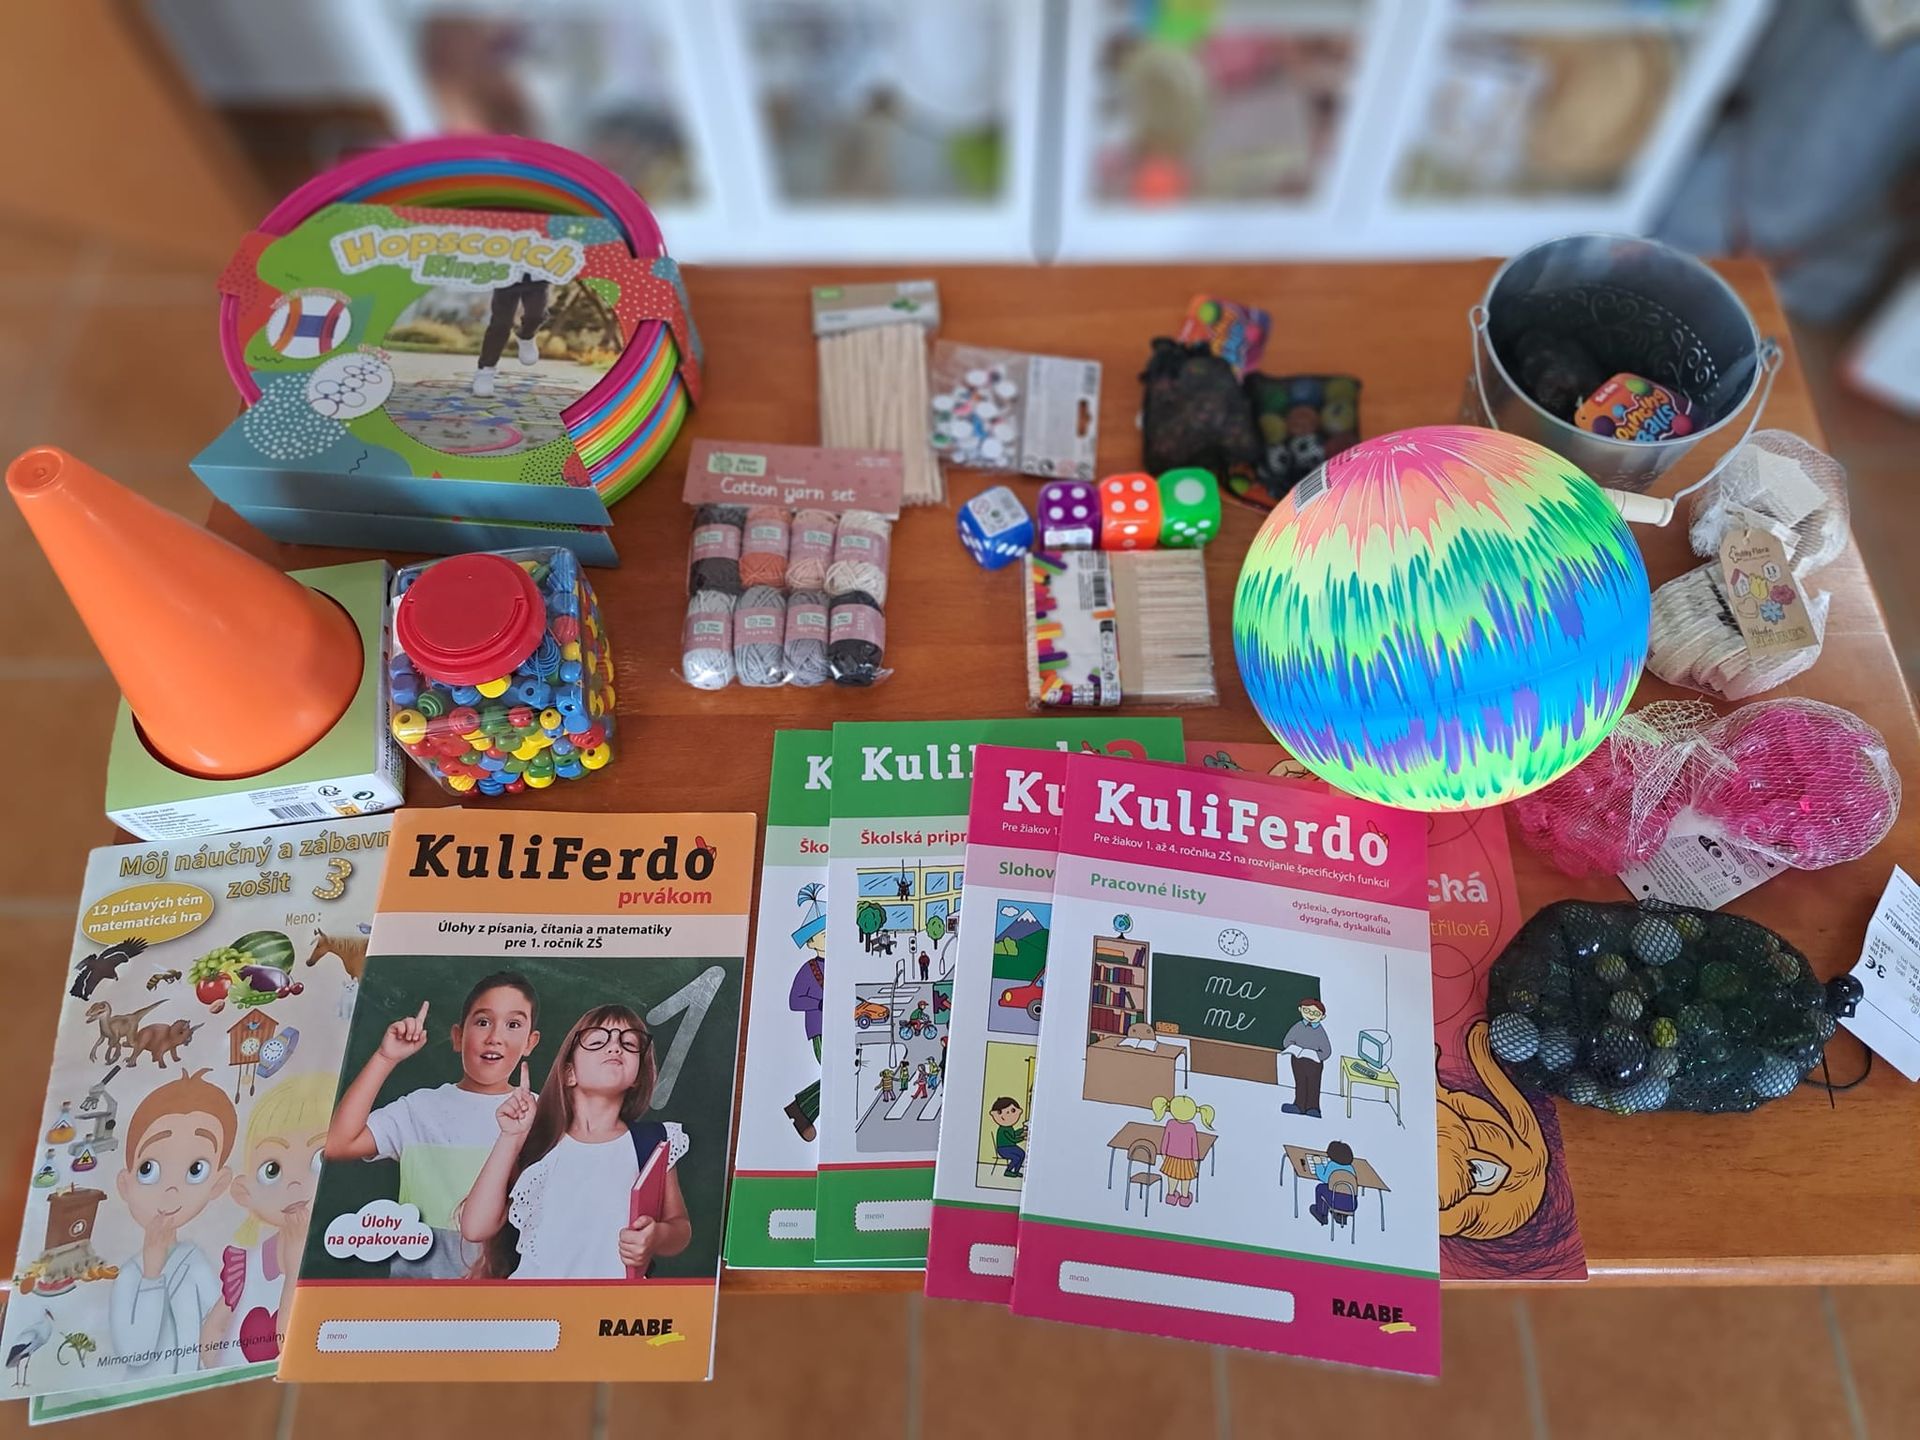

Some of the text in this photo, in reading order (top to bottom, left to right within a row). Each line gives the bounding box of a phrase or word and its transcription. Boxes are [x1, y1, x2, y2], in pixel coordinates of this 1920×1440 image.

[340, 231, 577, 279] Hopscotch
[421, 254, 511, 285] Rings
[1615, 388, 1670, 440] ouncing
[720, 476, 778, 497] Cotton
[784, 488, 825, 504] yarn
[831, 487, 857, 502] set
[861, 744, 977, 781] Kuli
[1002, 769, 1066, 816] Ku
[1002, 821, 1018, 832] Pre
[1020, 823, 1051, 835] žiakov
[1094, 779, 1389, 867] KuliFerdo
[800, 837, 829, 855] Ško
[860, 829, 967, 846] Školská pripr
[119, 829, 391, 878] Môj náučný a zábavn
[408, 834, 716, 881] KuliFerdo
[1093, 832, 1390, 889] Pre žiakov 1. až 4. ročníka ZŠ na rozvíjanie špecifických funkcií
[226, 857, 353, 901] zošit 3
[998, 861, 1055, 879] Slohov
[617, 888, 713, 909] prvákom
[1090, 873, 1207, 905] Pracovné listy
[1427, 872, 1489, 904] cká
[91, 893, 203, 917] 12 pútavých tém
[1291, 899, 1391, 925] dyslexia, dysortografia,
[88, 911, 203, 934] matematická hra
[285, 910, 322, 927] Meno:
[437, 920, 672, 937] Úlohy z písania, čítania a matematiky
[1299, 913, 1392, 937] dysgrafia, dyskalkúlia
[1430, 919, 1489, 937] třilová
[504, 935, 604, 951] pre 1. ročník ZŠ
[1884, 911, 1920, 953] SMURMELN
[1205, 975, 1267, 1000] ma
[1203, 1007, 1256, 1031] me
[361, 1213, 403, 1231] Úlohy
[327, 1231, 430, 1249] na opakovanie
[1068, 1273, 1090, 1284] meno
[1332, 1298, 1404, 1324] RAABE
[326, 1331, 348, 1341] meno
[598, 1318, 674, 1337] RAABE
[97, 1349, 162, 1368] Mimoriadny
[164, 1344, 203, 1360] projekt
[204, 1339, 230, 1352] siete
